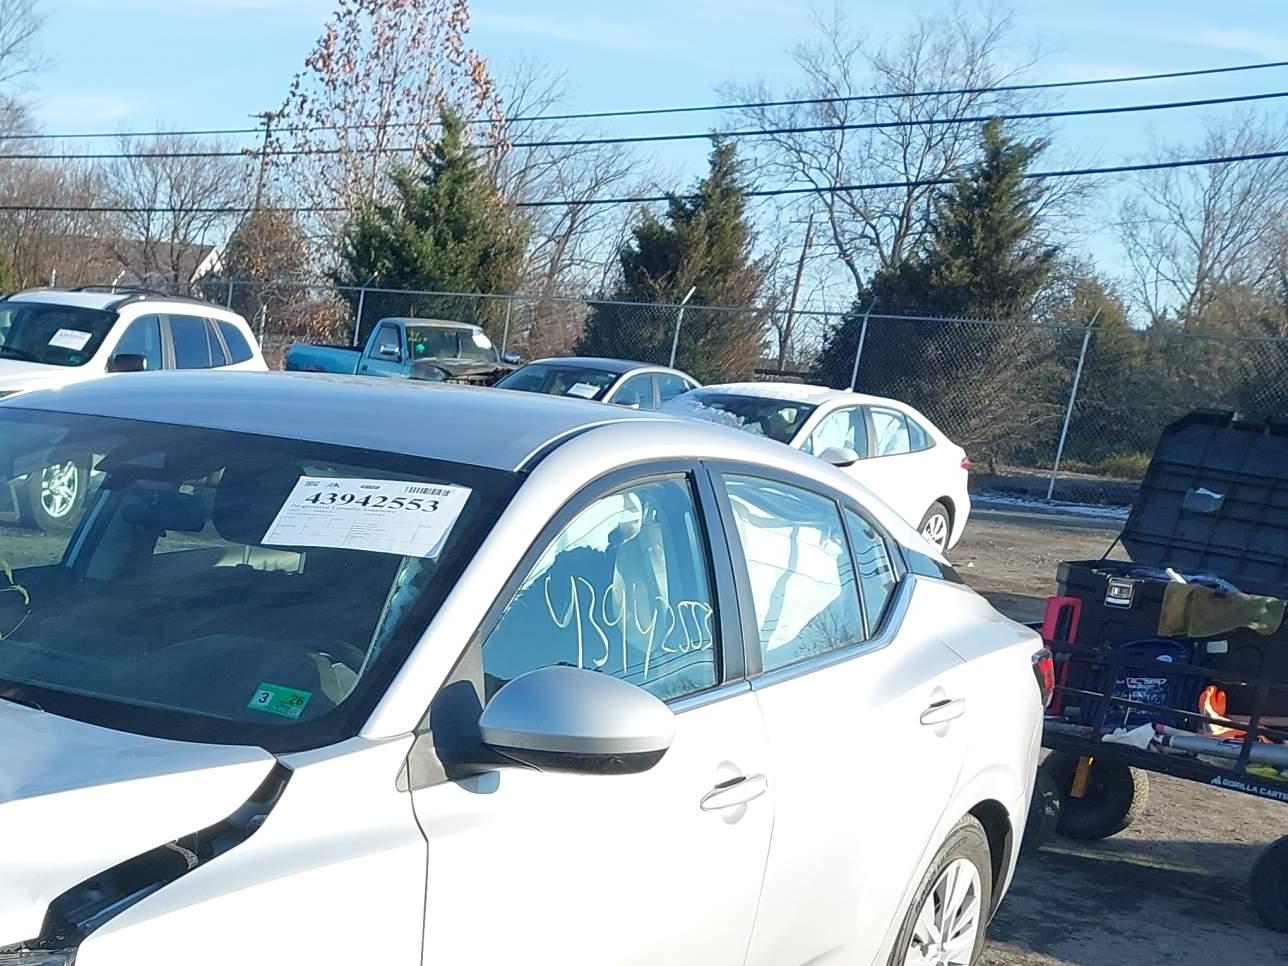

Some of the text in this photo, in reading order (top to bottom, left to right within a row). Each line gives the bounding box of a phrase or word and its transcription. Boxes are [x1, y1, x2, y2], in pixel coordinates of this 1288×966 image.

[304, 492, 440, 512] 43942553
[258, 692, 306, 706] 3 26
[1222, 778, 1258, 793] GORILLA
